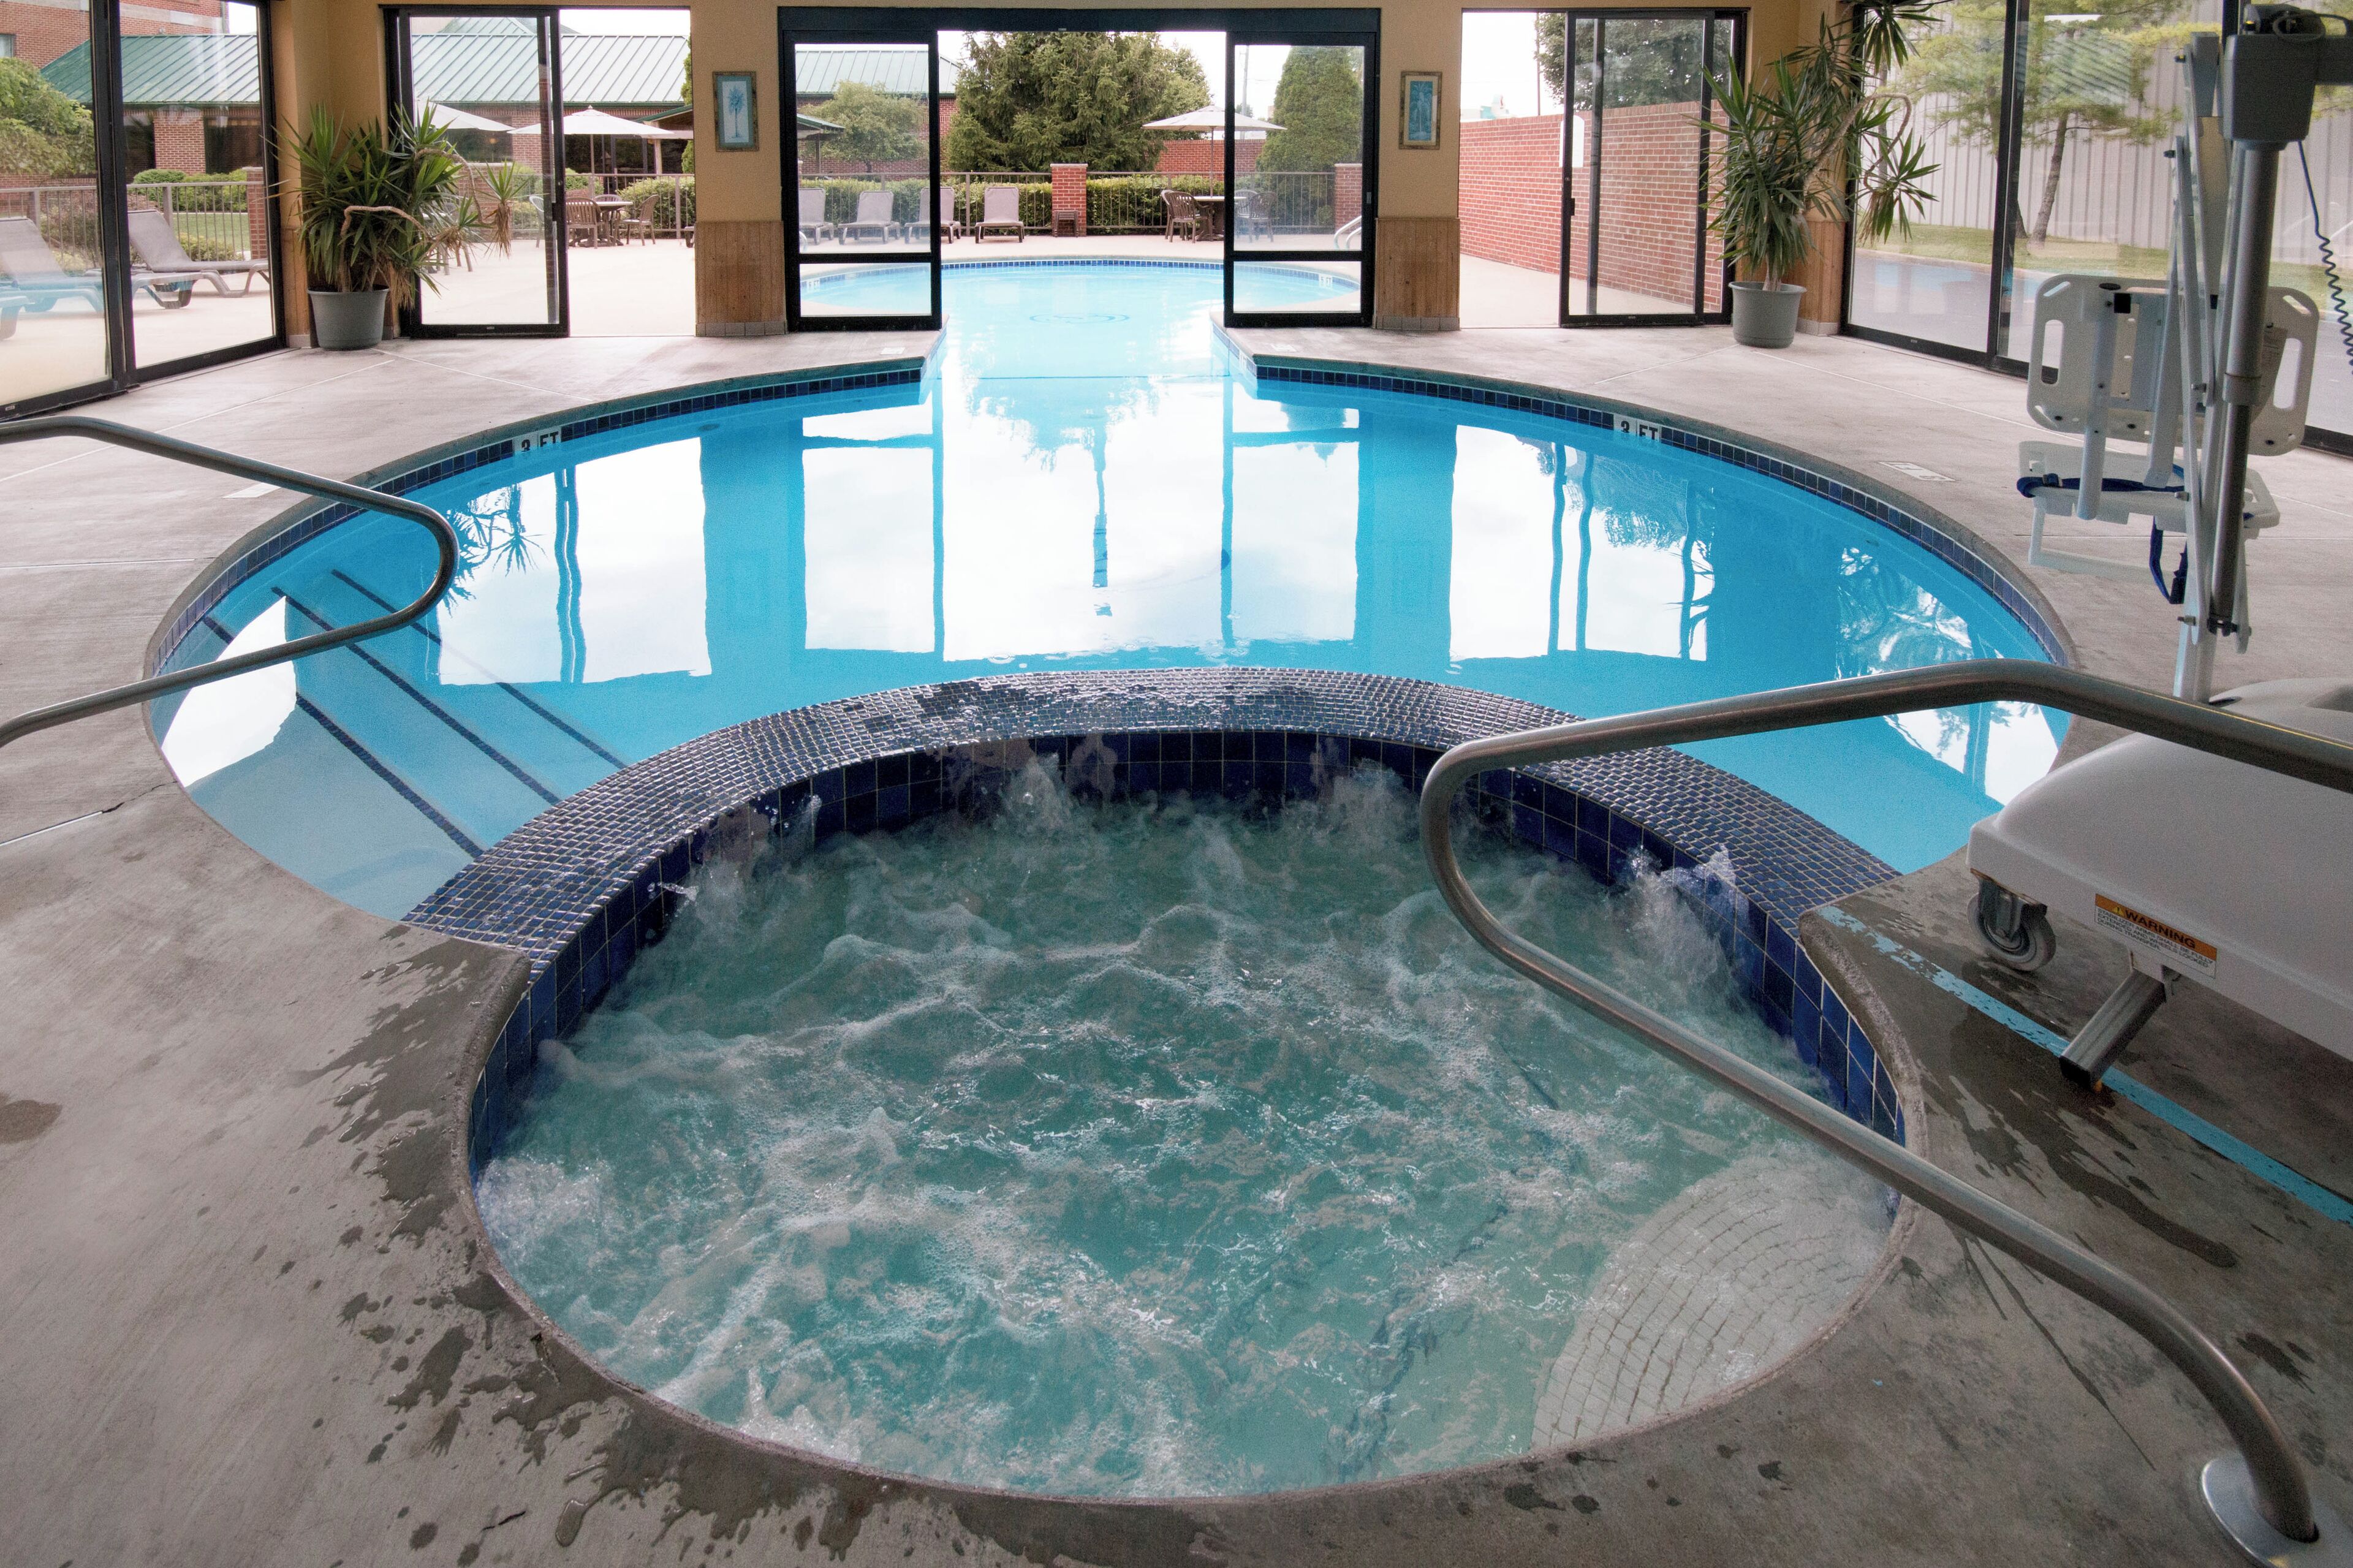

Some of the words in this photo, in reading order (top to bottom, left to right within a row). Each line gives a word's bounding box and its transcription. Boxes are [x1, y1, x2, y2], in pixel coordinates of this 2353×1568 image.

[540, 431, 559, 447] FT
[1639, 424, 1658, 440] FT
[2097, 918, 2123, 933] DURING
[2097, 908, 2134, 927] STABILIZER
[2135, 925, 2157, 937] ARMS
[2158, 934, 2178, 948] SHALL
[2191, 952, 2213, 964] FULLY
[2124, 909, 2196, 949] WARNING
[2097, 914, 2132, 931] EXTENDED
[2134, 930, 2149, 939] AND
[2150, 938, 2178, 953] WHEELS
[2179, 952, 2208, 967] LOCKED
